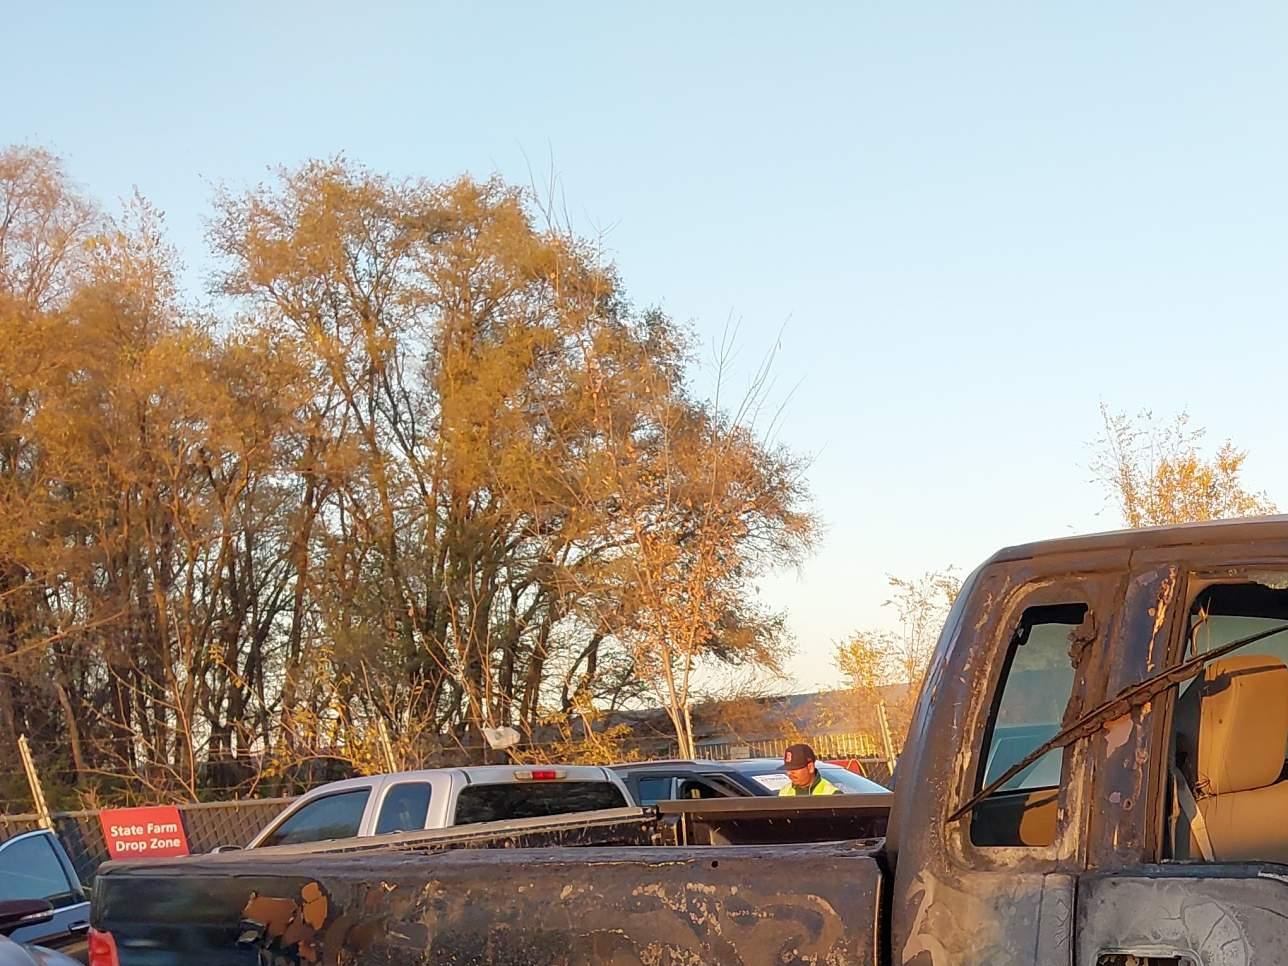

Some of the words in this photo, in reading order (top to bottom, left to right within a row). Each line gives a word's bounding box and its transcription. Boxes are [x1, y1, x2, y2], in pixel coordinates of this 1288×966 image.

[111, 825, 144, 837] State
[147, 823, 177, 834] Farm
[116, 841, 147, 852] Drop
[150, 838, 181, 849] Zone
